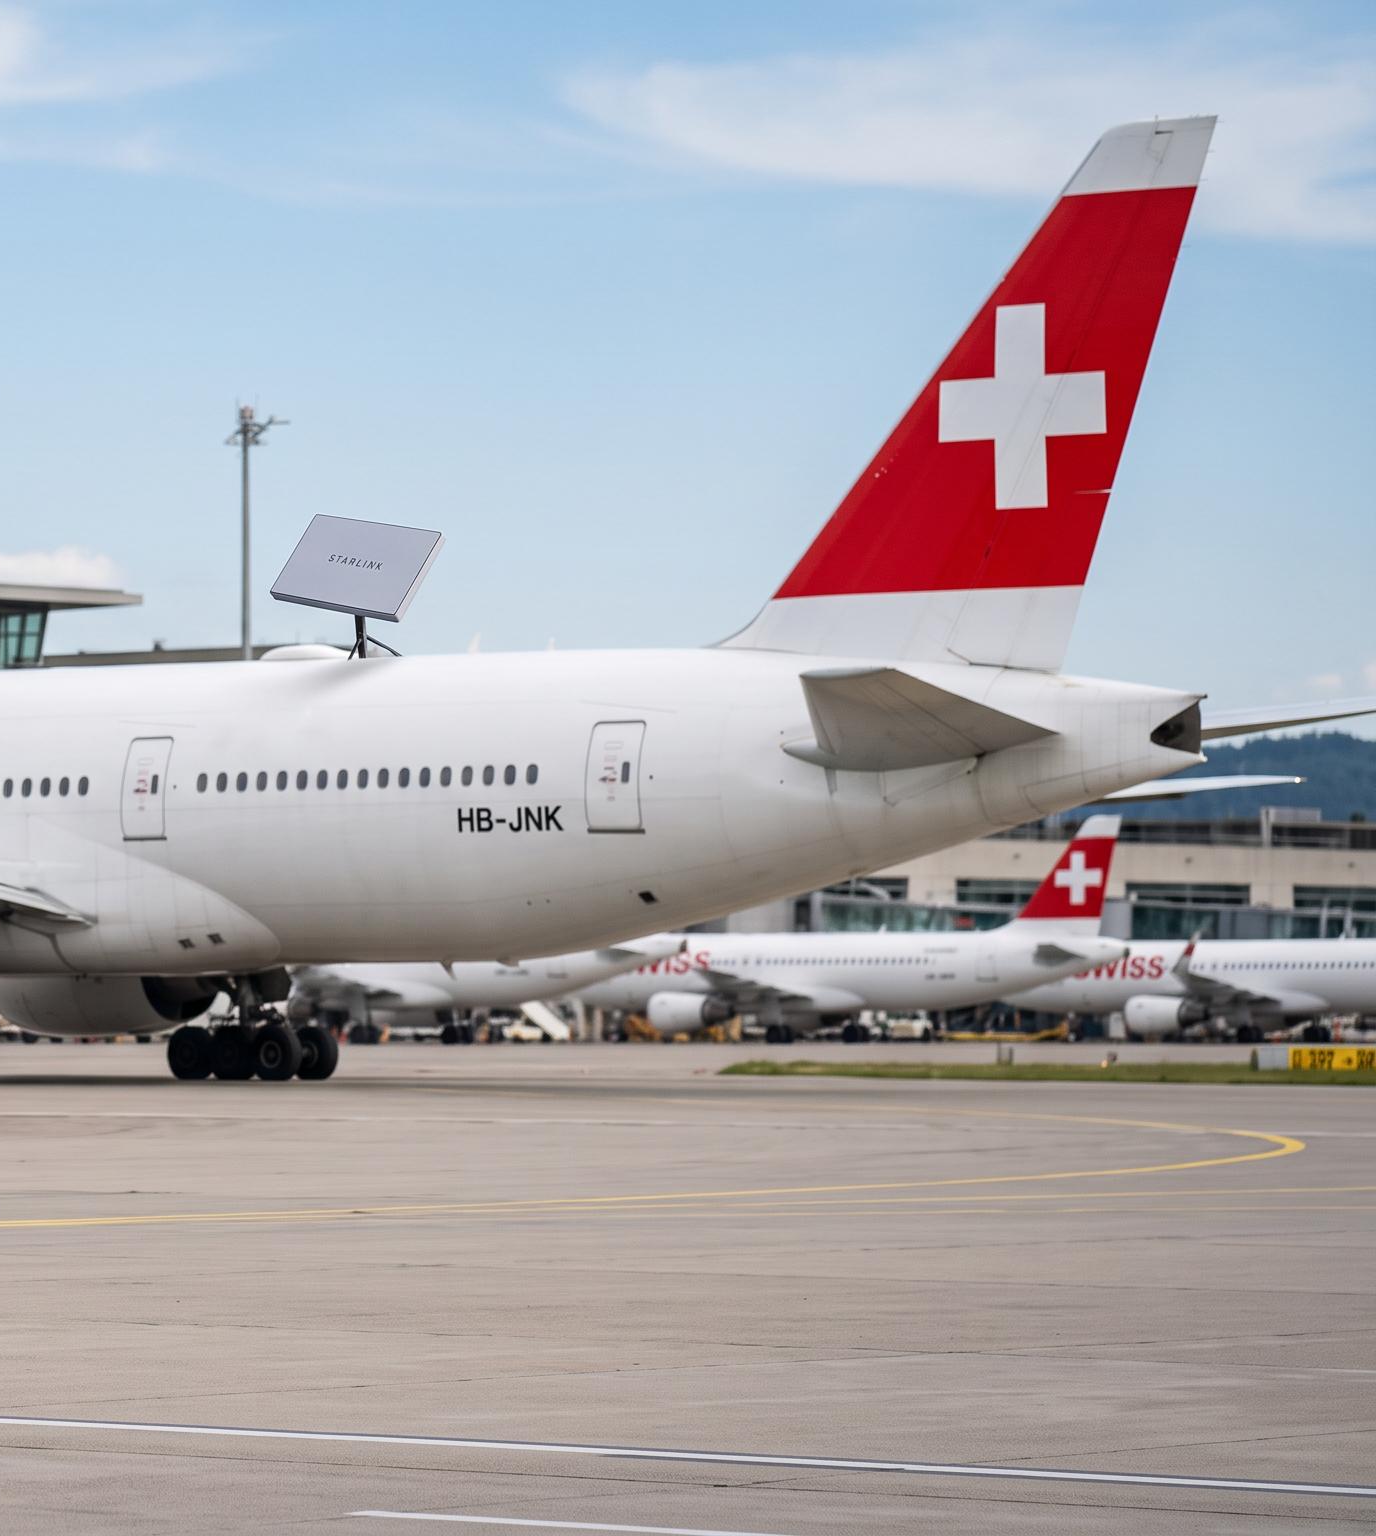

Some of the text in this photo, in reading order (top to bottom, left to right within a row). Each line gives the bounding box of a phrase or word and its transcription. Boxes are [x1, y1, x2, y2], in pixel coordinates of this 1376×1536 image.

[328, 554, 384, 571] STARLINK
[457, 805, 564, 833] HB-JNK
[1073, 956, 1164, 979] WISS
